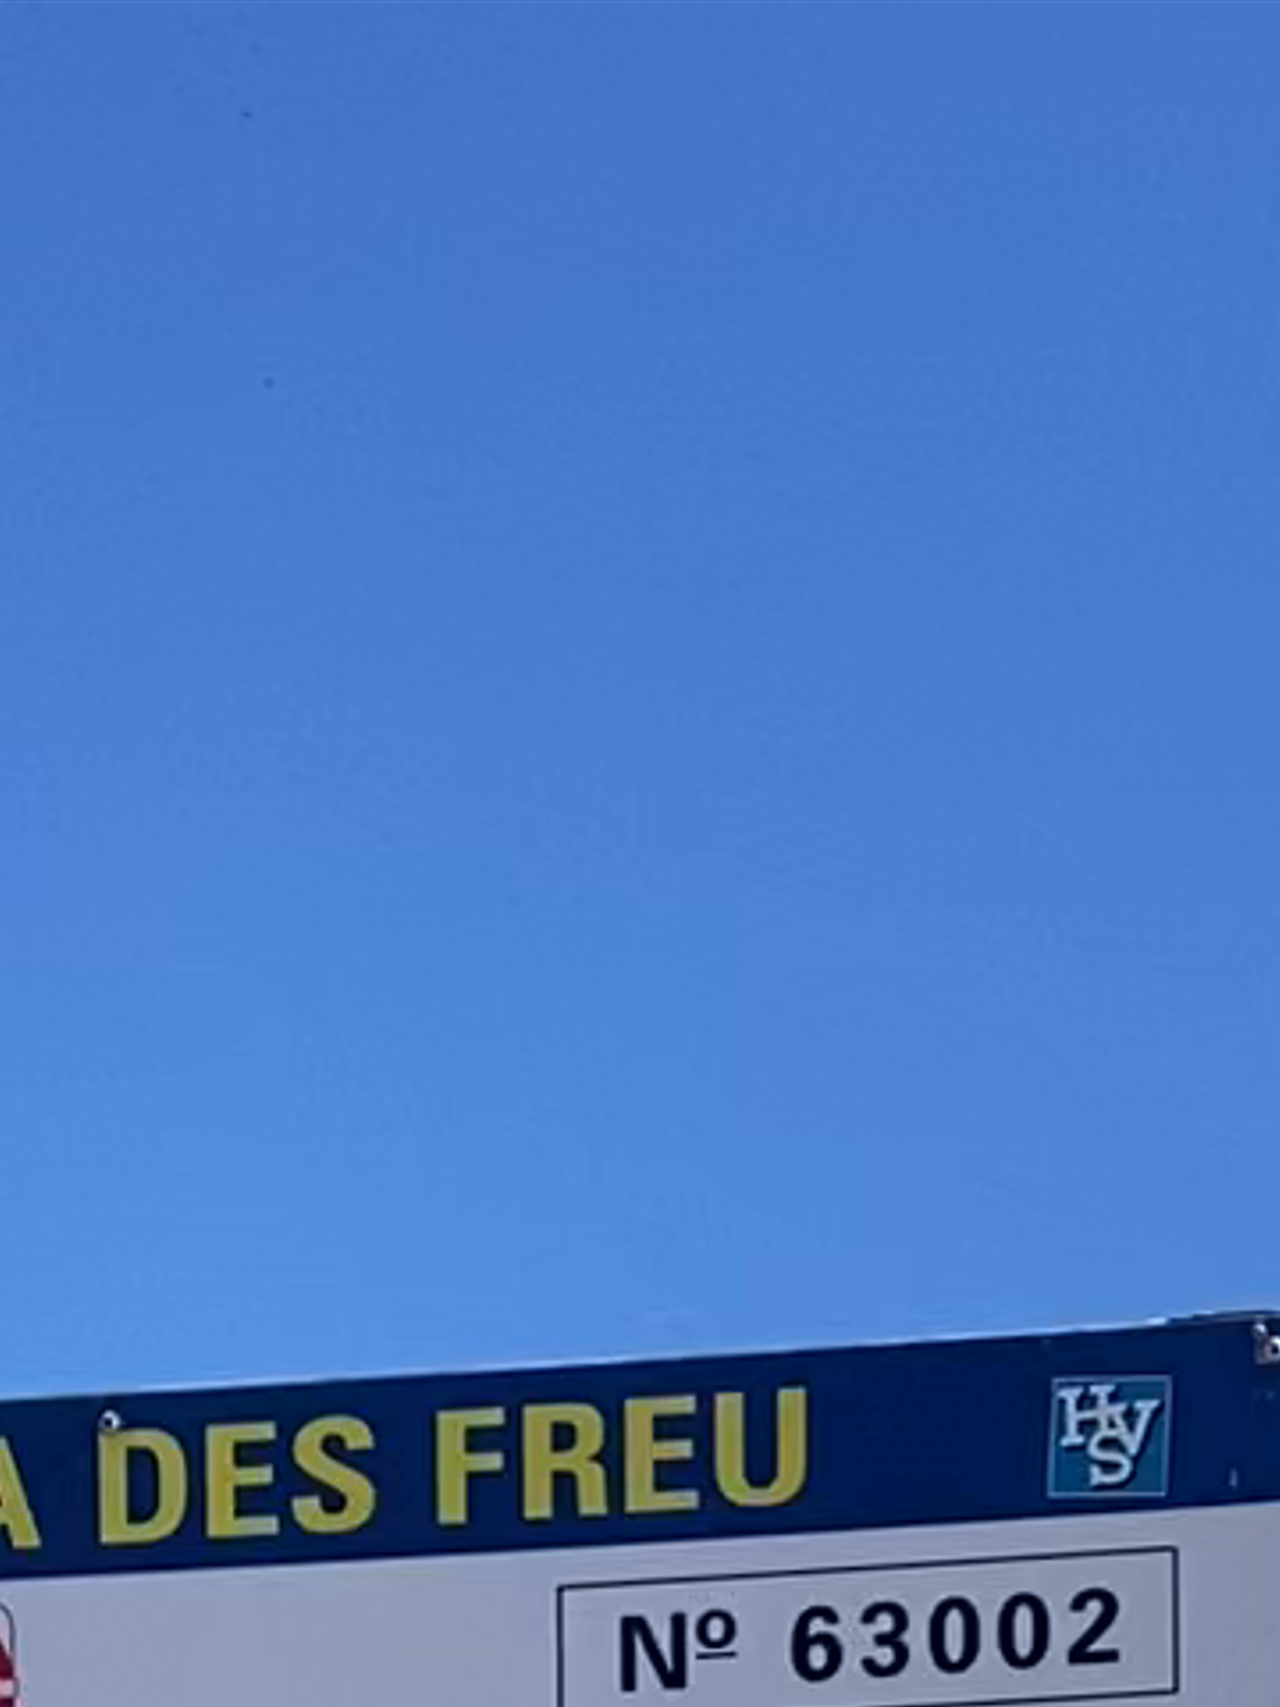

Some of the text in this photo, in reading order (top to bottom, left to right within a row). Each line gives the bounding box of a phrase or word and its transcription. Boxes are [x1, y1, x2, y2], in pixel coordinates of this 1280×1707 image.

[100, 1418, 378, 1545] DES
[436, 1390, 807, 1523] FREU
[790, 1587, 1121, 1683] 63002
